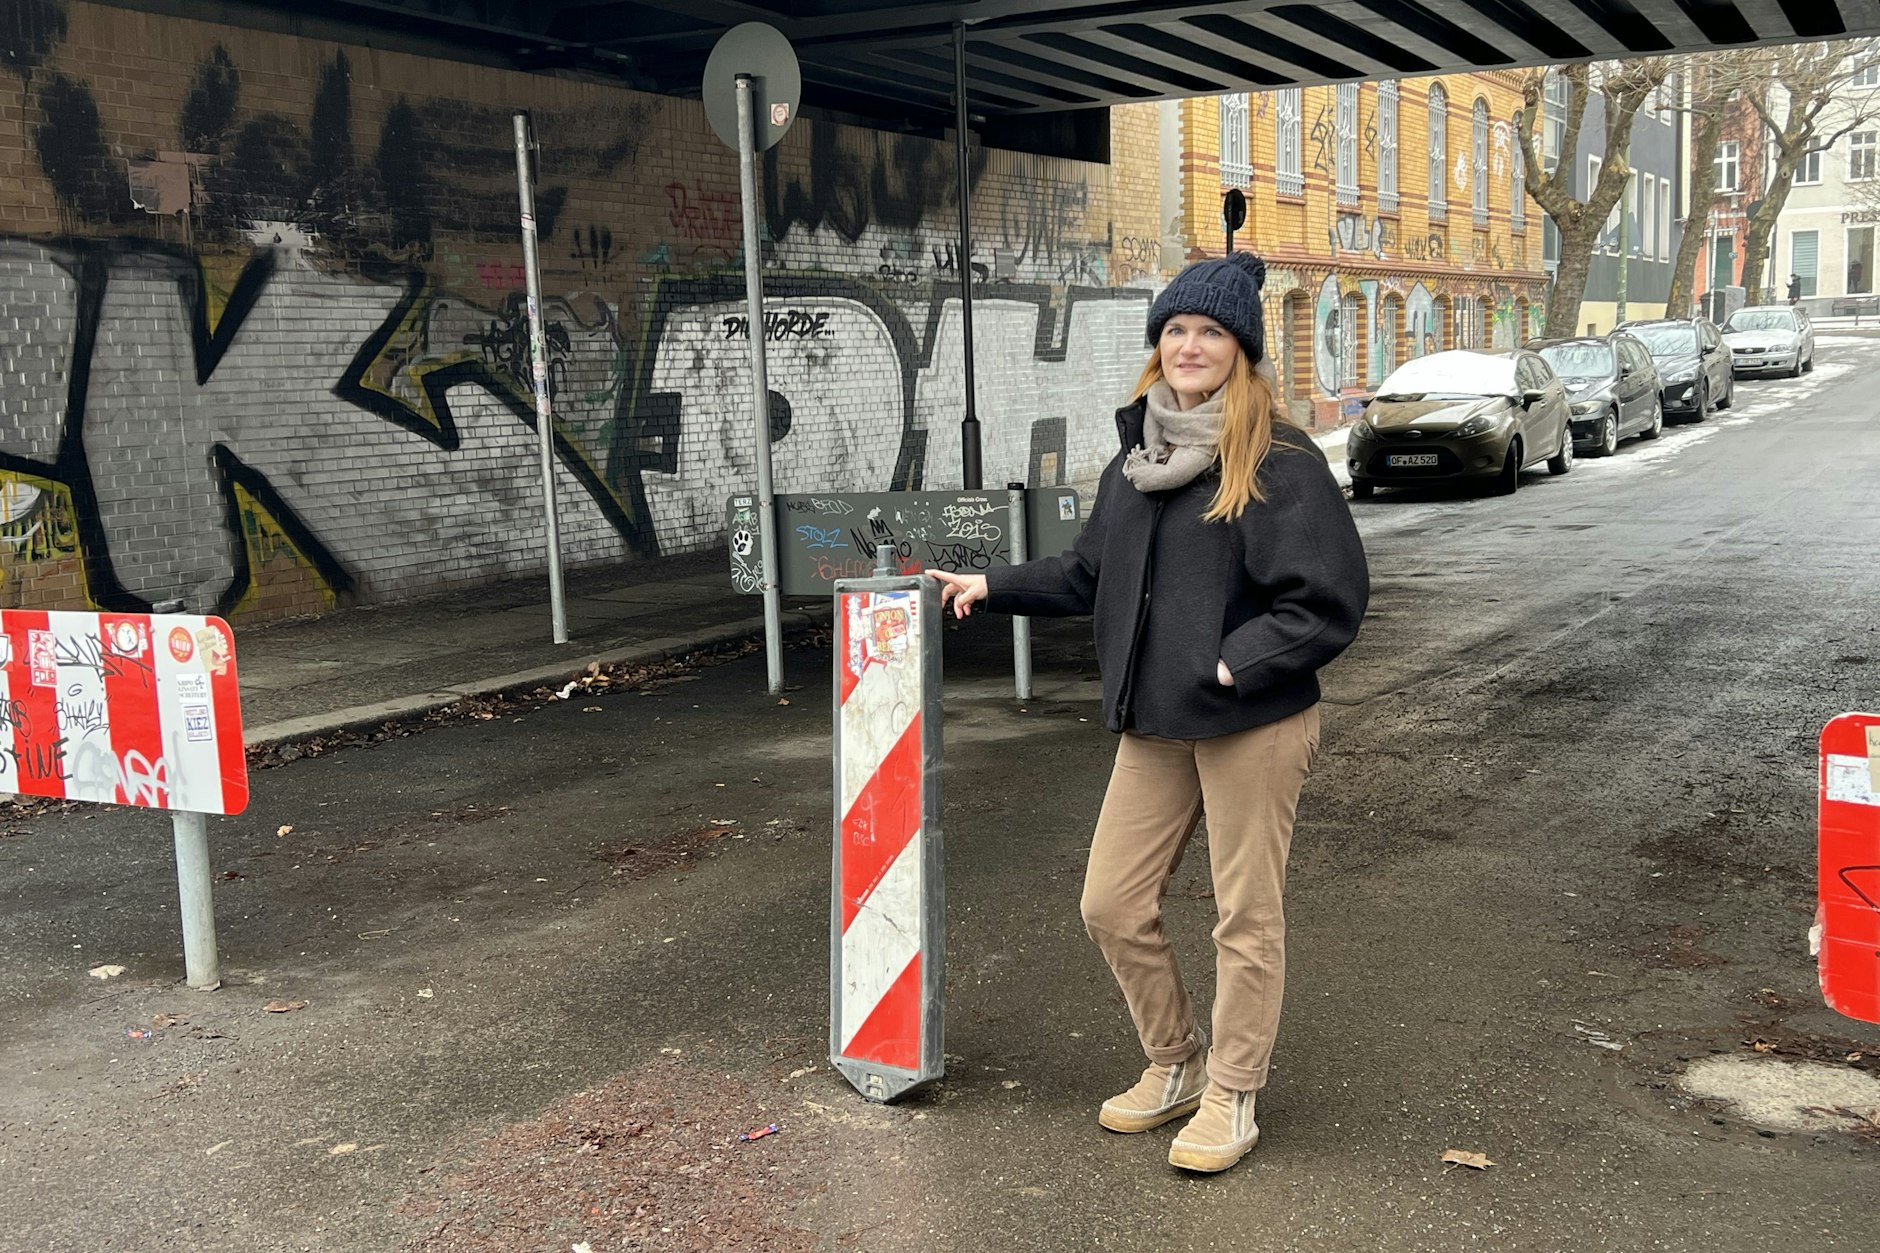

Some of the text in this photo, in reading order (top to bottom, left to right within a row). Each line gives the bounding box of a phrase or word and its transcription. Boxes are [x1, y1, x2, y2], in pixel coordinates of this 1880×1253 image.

[1391, 455, 1437, 465] OF AZ 520
[734, 497, 752, 507] TERZ
[873, 609, 905, 622] UNION
